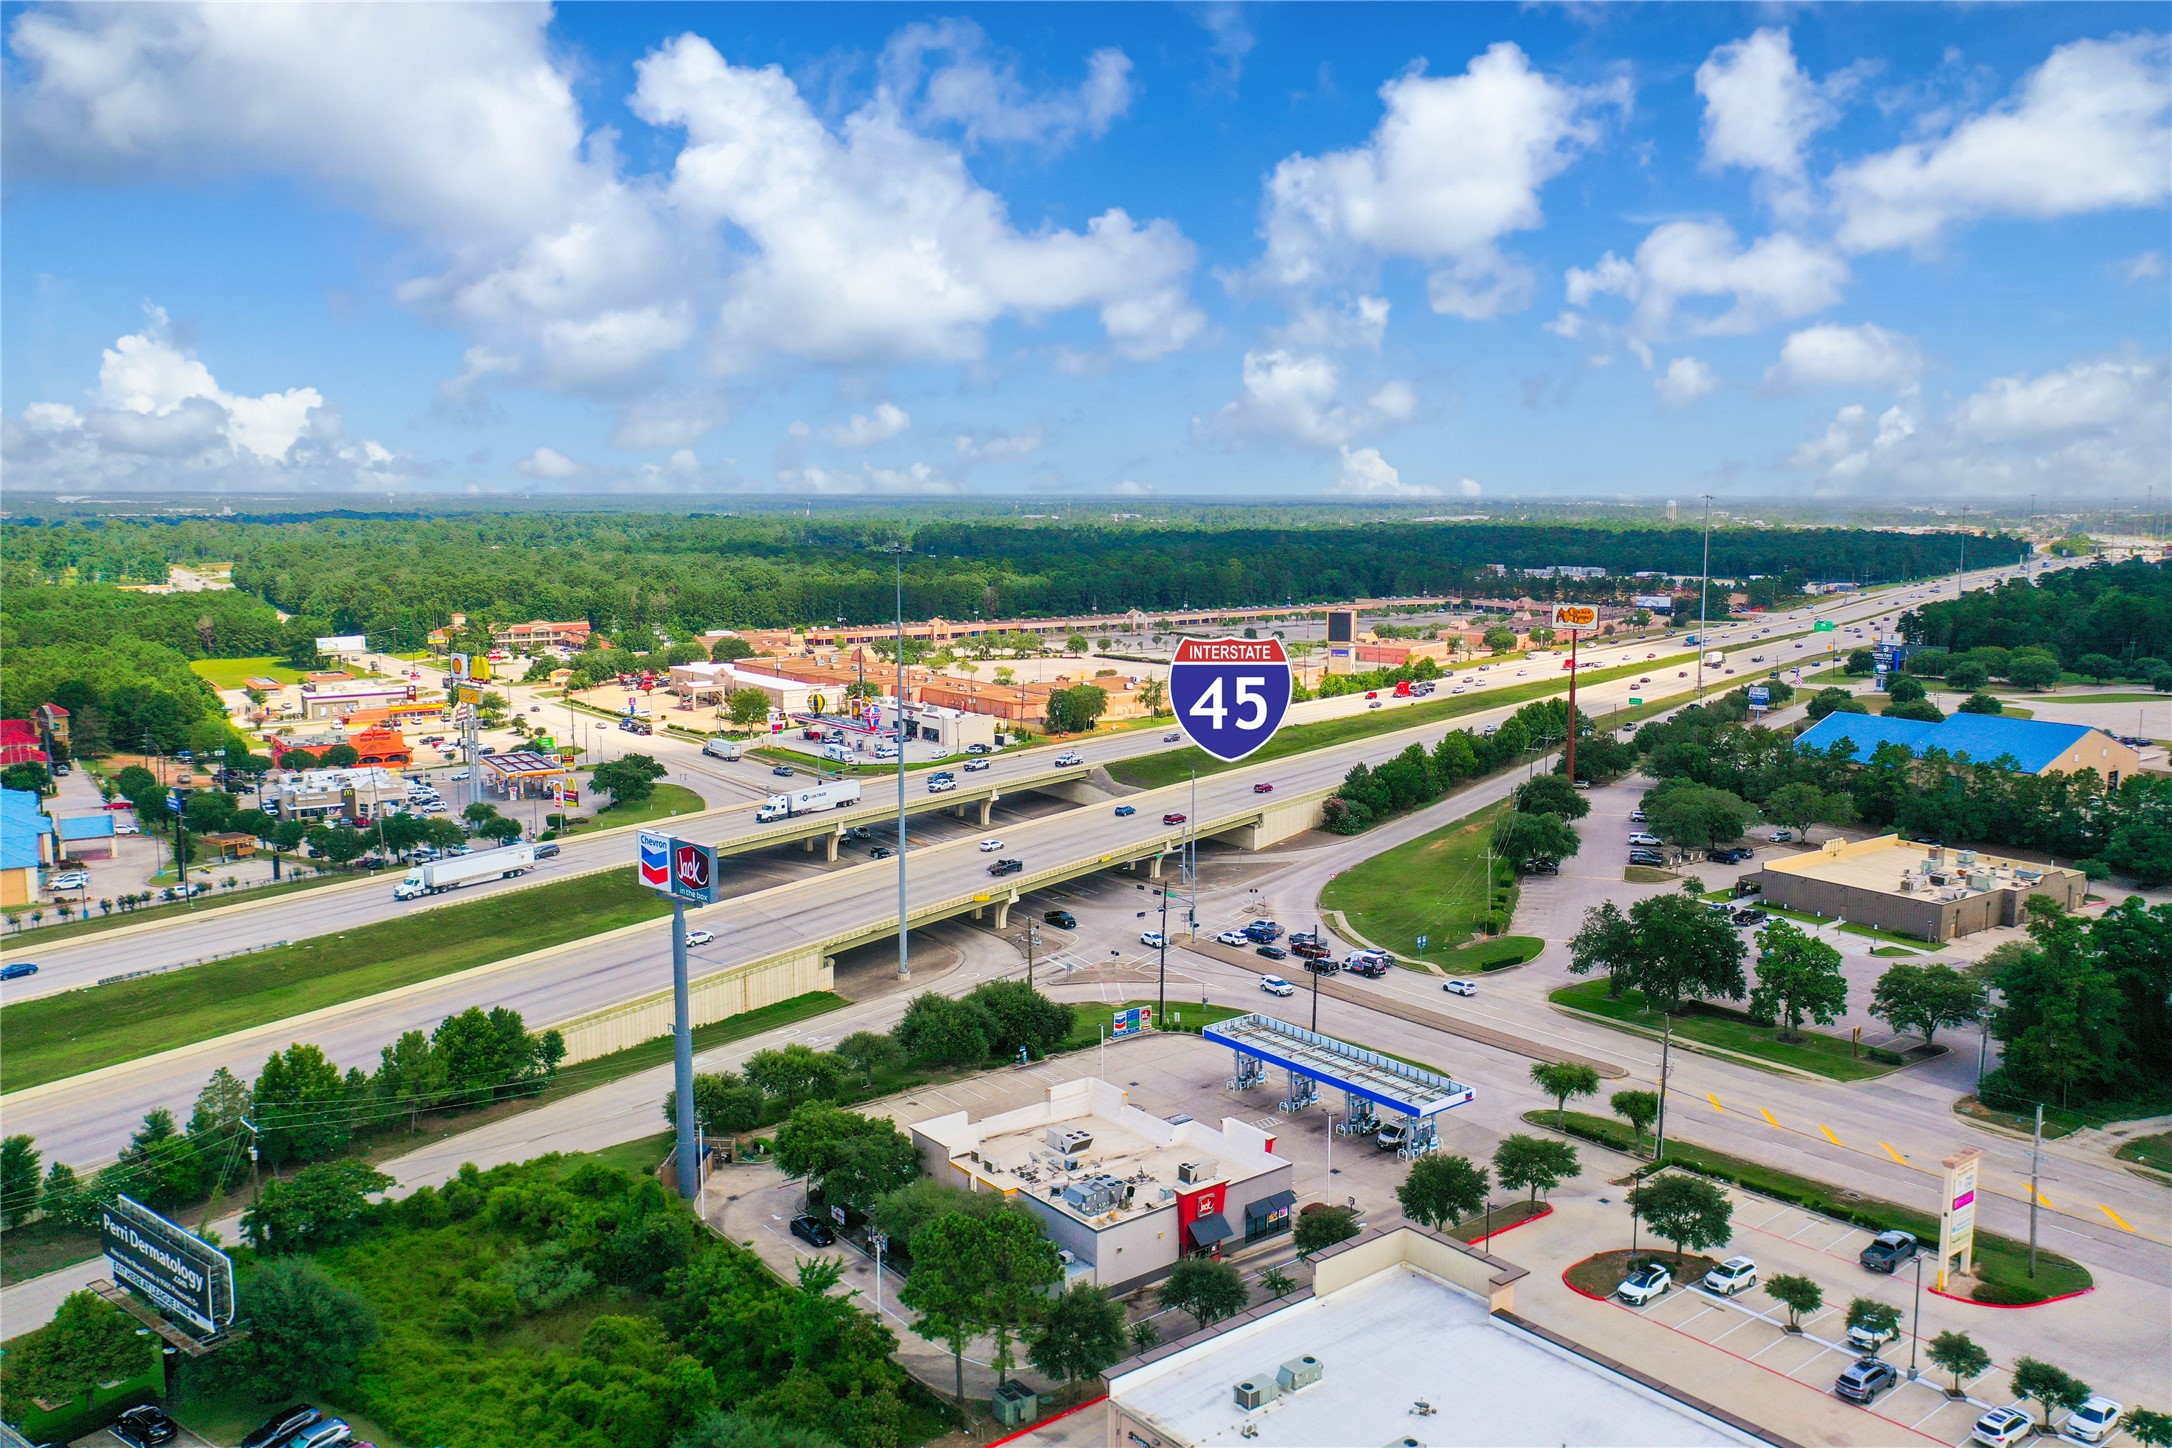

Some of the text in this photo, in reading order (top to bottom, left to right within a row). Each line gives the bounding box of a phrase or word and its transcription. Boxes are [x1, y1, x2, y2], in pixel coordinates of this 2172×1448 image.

[640, 835, 667, 849] Chevron
[678, 851, 708, 885] Jack
[686, 889, 696, 898] the
[696, 892, 708, 901] box
[104, 1214, 203, 1292] Perri Dermatology
[113, 1261, 190, 1316] EXIT HERE AT LEAGUE LINE
